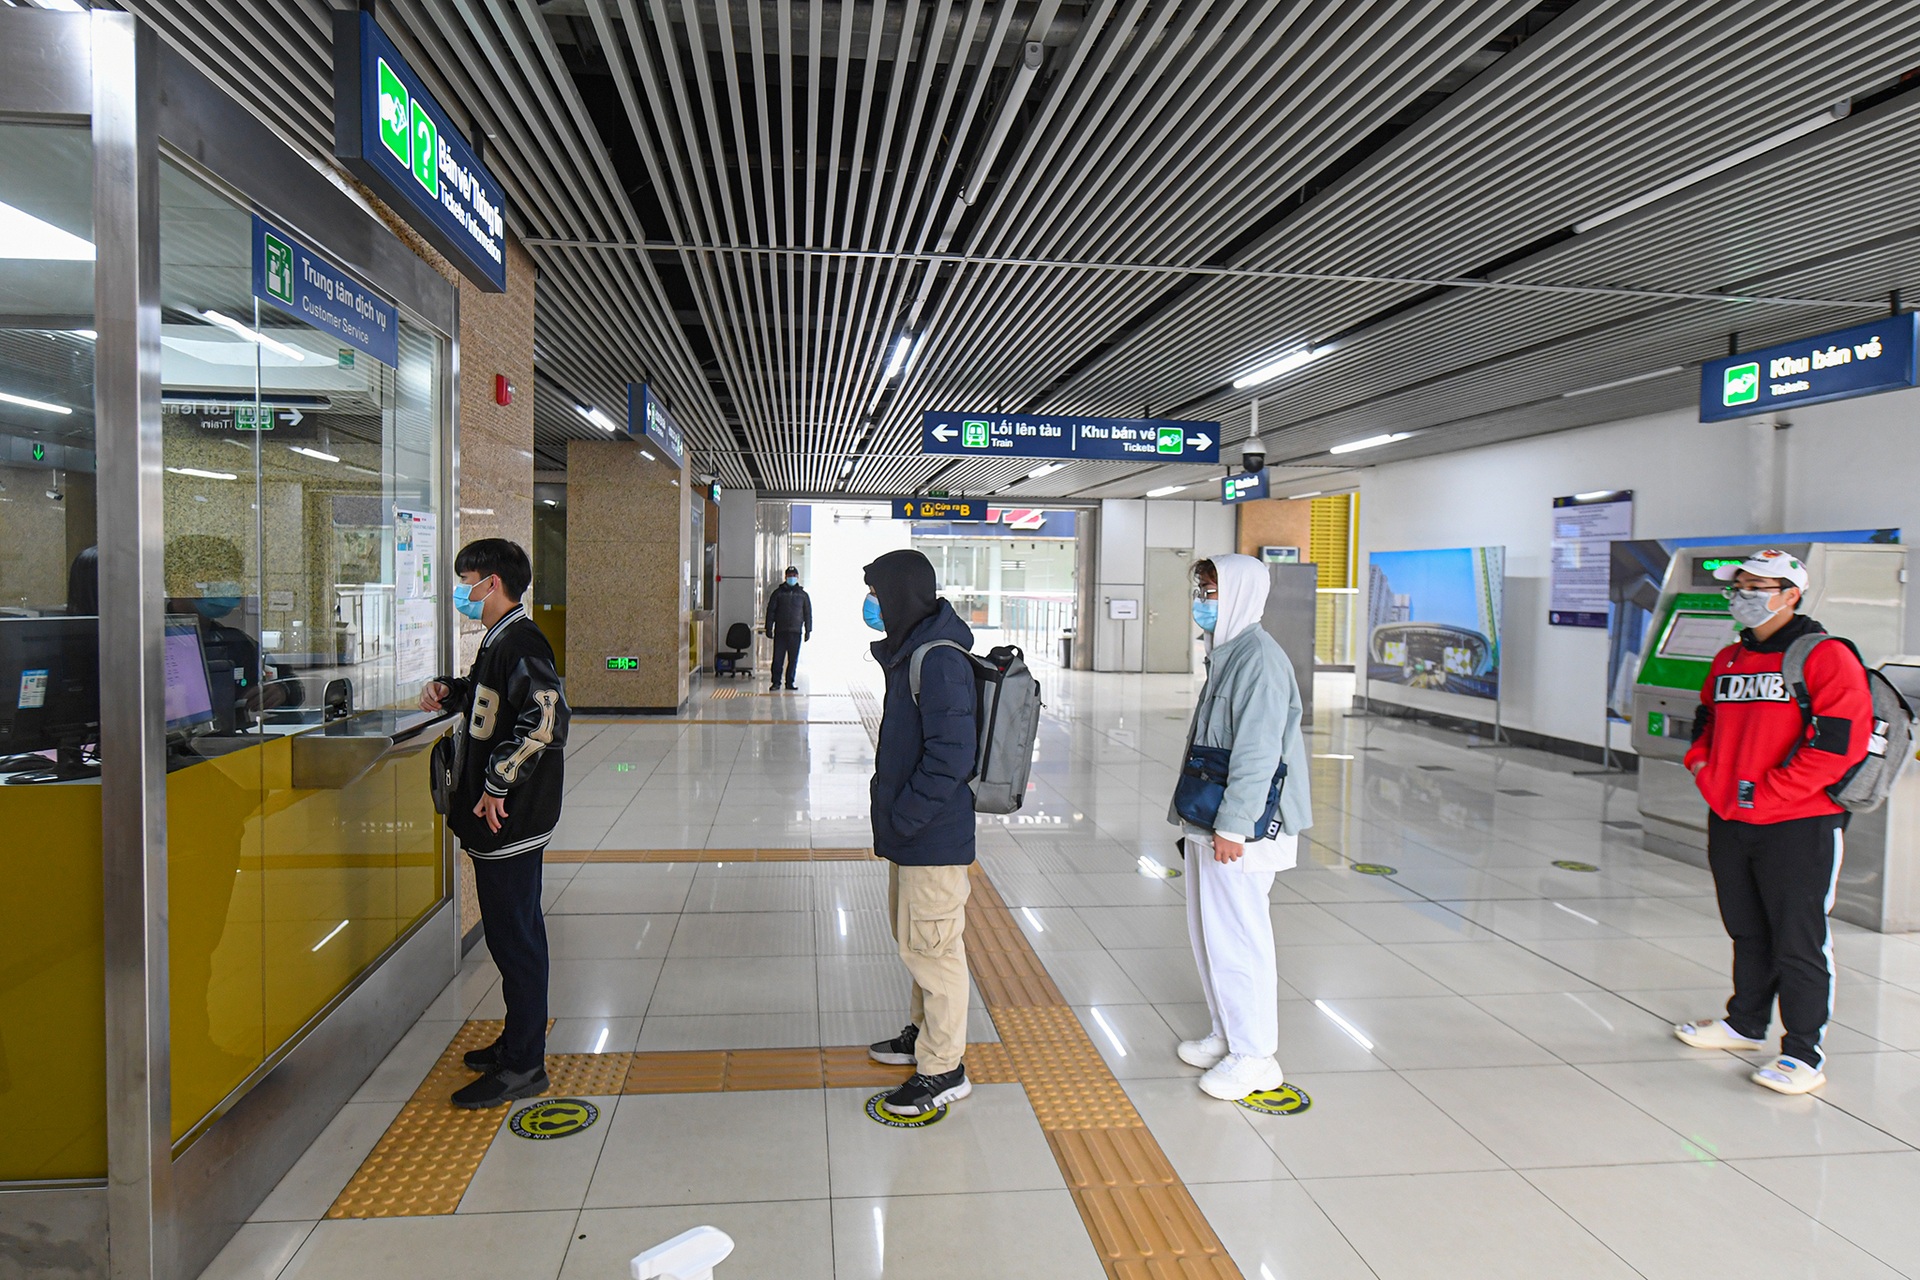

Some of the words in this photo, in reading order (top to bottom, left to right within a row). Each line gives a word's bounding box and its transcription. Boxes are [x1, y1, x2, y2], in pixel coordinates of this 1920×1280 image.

[437, 134, 458, 188] Bán
[439, 180, 465, 226] Tickets
[468, 212, 502, 265] Information
[301, 257, 334, 301] Trung
[335, 280, 354, 308] tâm
[355, 293, 374, 322] dịch
[375, 309, 387, 332] vụ
[302, 295, 341, 329] Customer
[342, 318, 369, 345] Service
[1769, 356, 1810, 379] Khu
[1812, 346, 1852, 370] bán
[1854, 336, 1883, 361] vé
[1769, 380, 1810, 396] Tickets
[991, 419, 1013, 436] Lối
[1015, 421, 1037, 436] lên
[1039, 423, 1062, 437] tàu
[991, 438, 1013, 448] Train
[1081, 424, 1109, 439] Khu
[1111, 426, 1137, 440] bán
[1139, 427, 1156, 441] vé
[1122, 442, 1156, 453] Tickets
[960, 504, 971, 517] B
[469, 682, 500, 741] B
